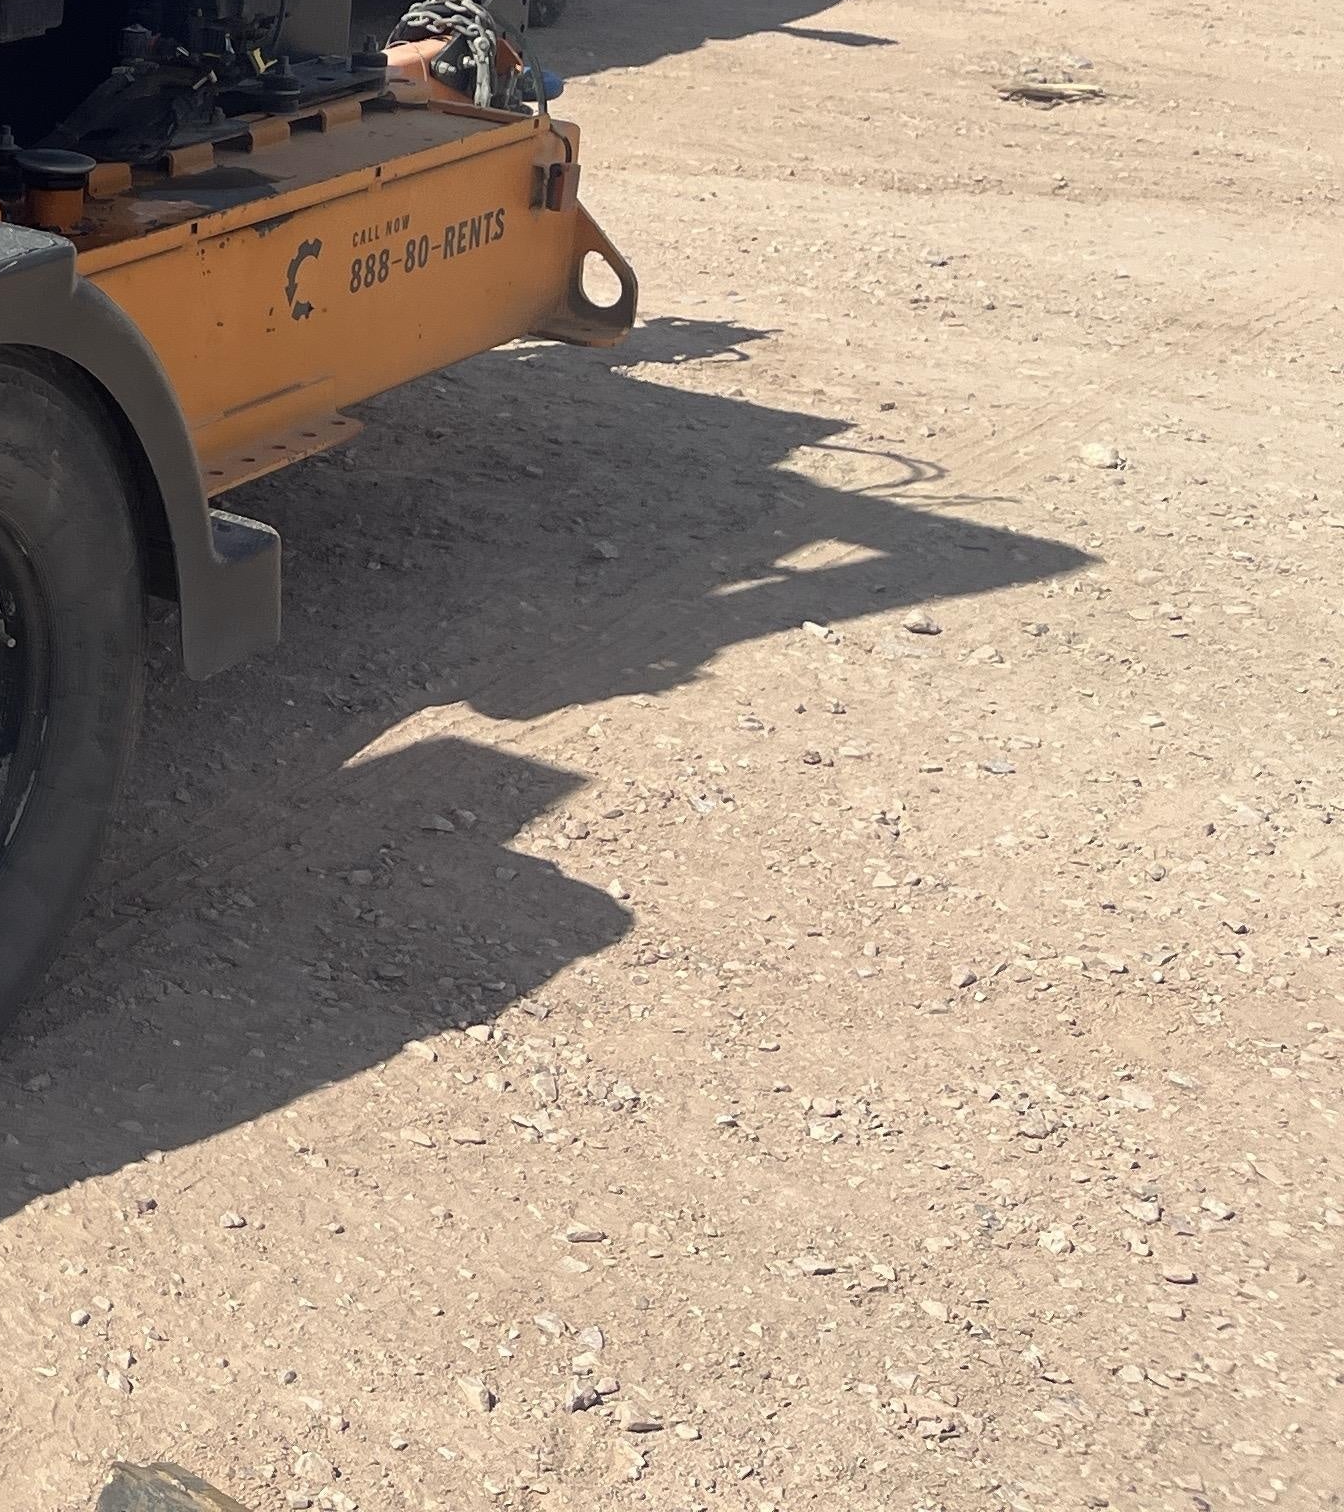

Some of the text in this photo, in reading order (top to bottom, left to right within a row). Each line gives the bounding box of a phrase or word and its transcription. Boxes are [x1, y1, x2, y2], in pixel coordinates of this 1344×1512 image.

[349, 207, 506, 294] 888-80-RENTS
[352, 214, 410, 248] CALL NOW
